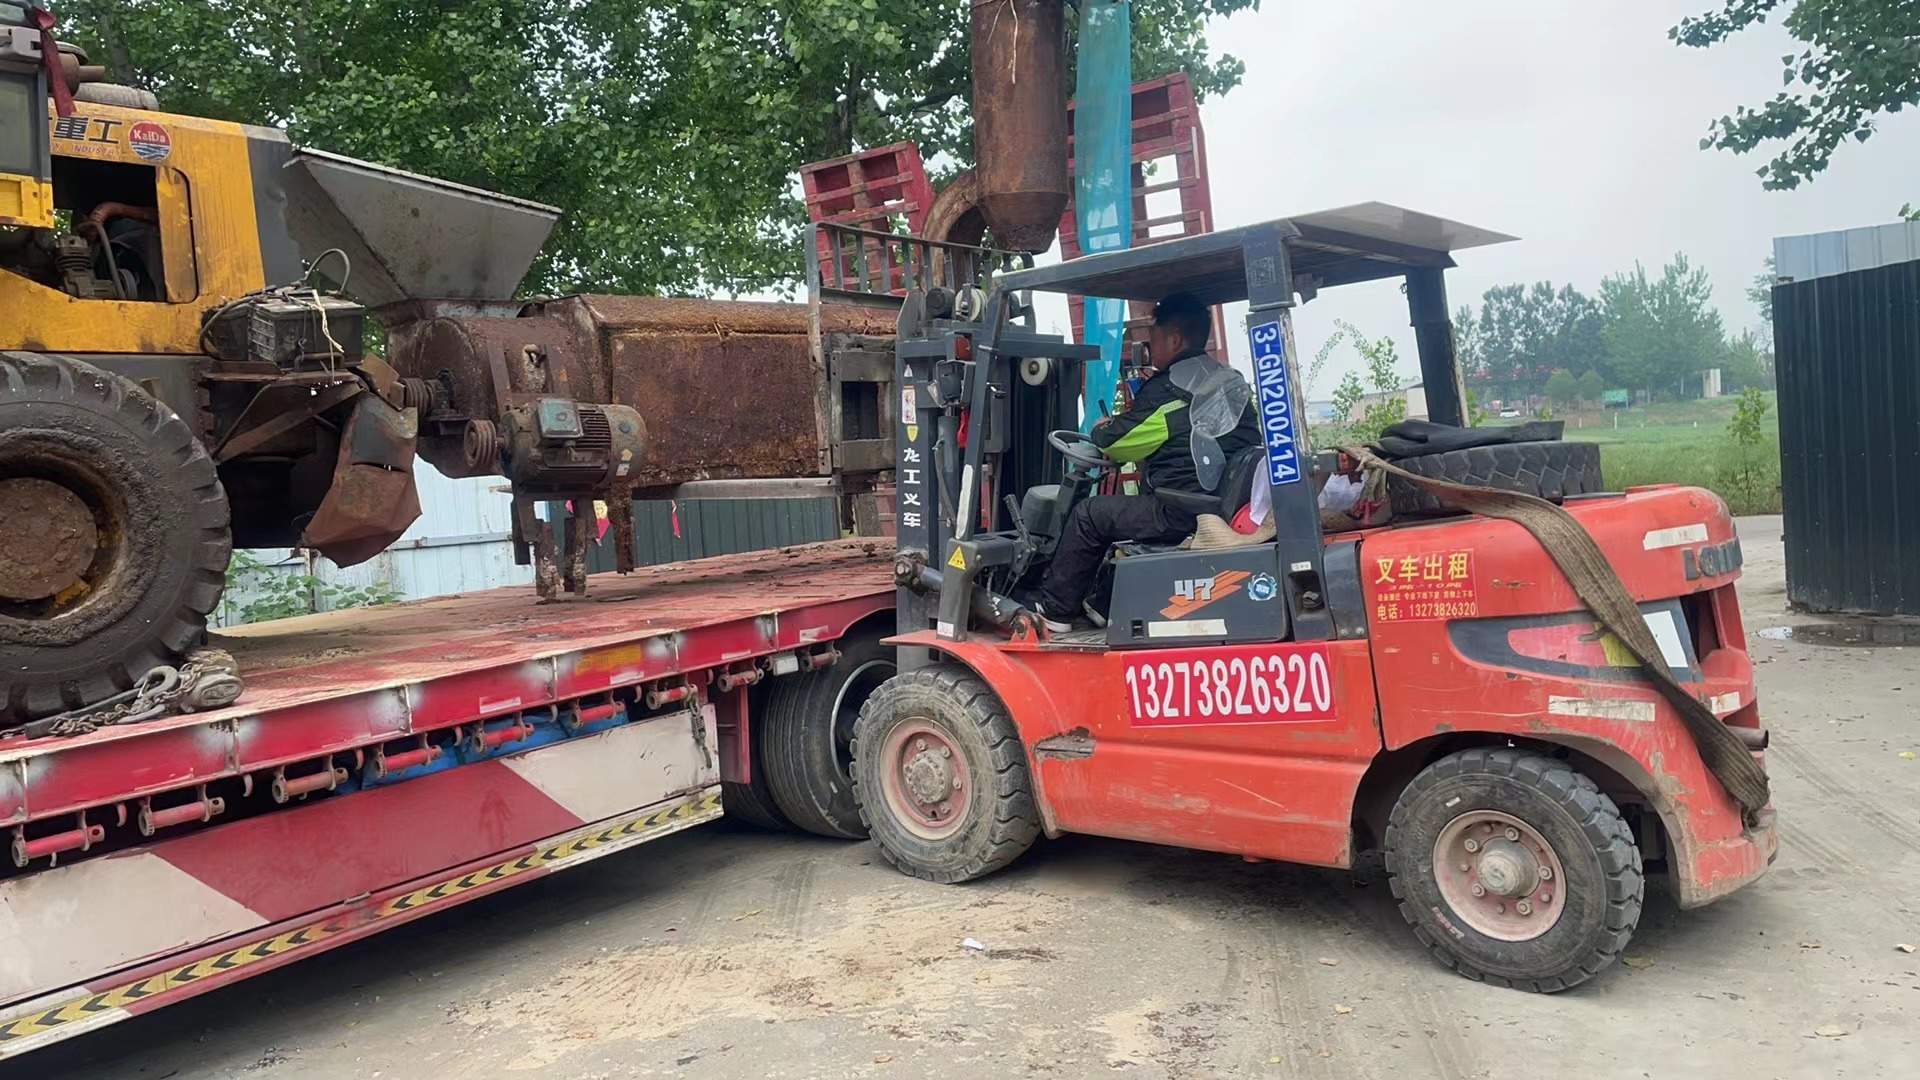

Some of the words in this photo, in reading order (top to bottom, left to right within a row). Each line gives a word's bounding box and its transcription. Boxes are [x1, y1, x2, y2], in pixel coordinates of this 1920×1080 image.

[48, 116, 122, 144] 重工
[1254, 327, 1297, 479] 3-GN200414
[1375, 552, 1469, 585] 叉车出租
[1409, 602, 1477, 618] 13273826320
[1126, 652, 1331, 718] 13273826320
